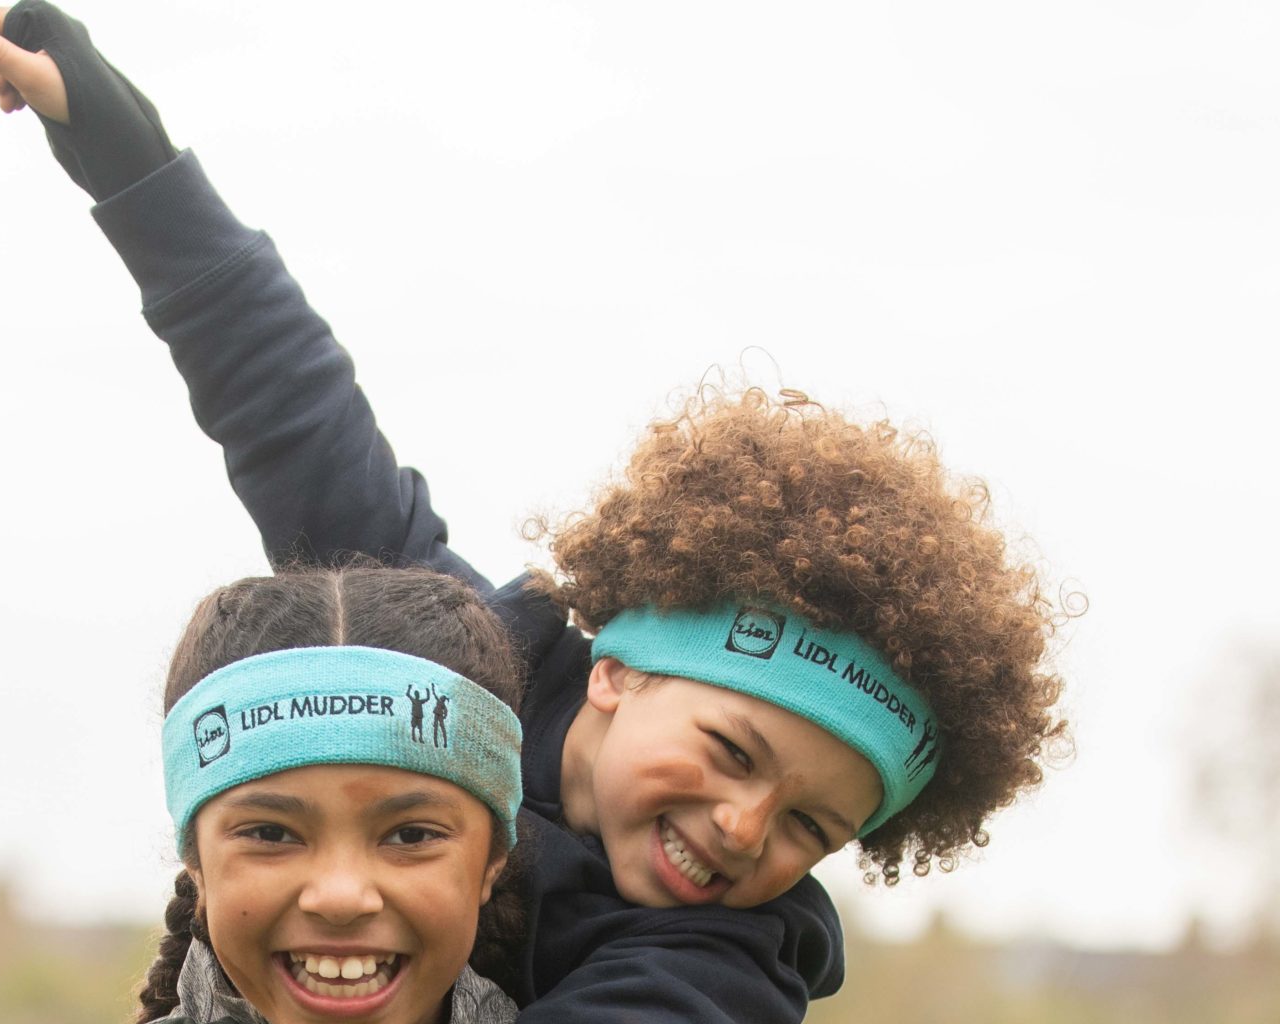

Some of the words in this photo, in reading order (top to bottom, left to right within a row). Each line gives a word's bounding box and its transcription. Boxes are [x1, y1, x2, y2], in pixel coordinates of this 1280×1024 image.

[241, 702, 284, 731] LIDL
[290, 695, 395, 719] MUDDER
[793, 637, 838, 673] LIDL
[841, 662, 916, 733] MUDDER
